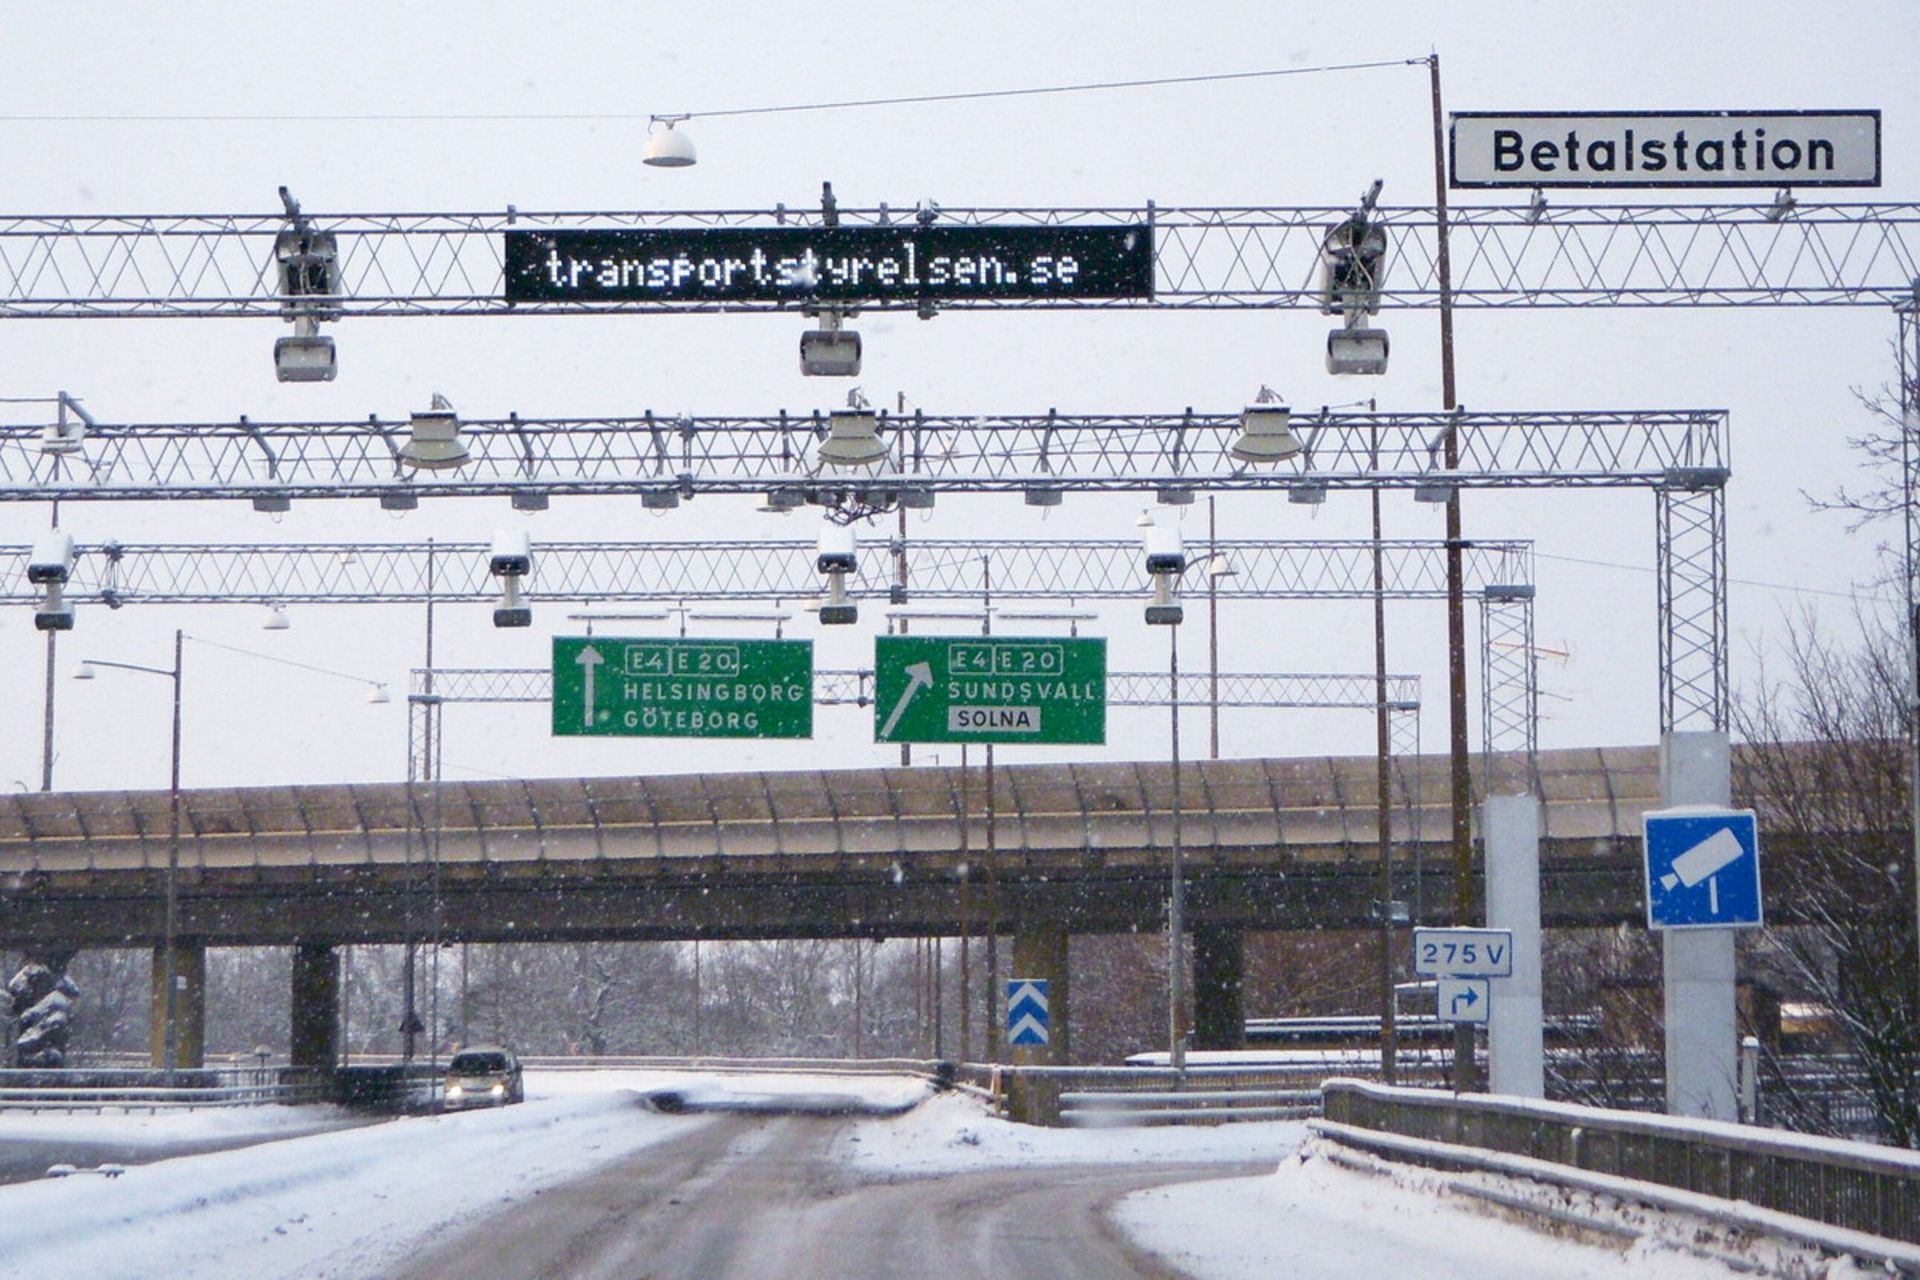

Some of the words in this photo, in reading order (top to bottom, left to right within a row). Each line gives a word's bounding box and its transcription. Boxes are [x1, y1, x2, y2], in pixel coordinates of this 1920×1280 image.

[1493, 128, 1835, 172] Betalstation
[546, 242, 1079, 287] transportstyrelsen.se
[633, 652, 664, 669] E4
[698, 653, 731, 669] 20
[957, 651, 986, 667] E4
[1022, 652, 1054, 669] 20
[623, 683, 804, 702] HELSINGBORG
[949, 682, 1095, 700] SUNDSVALL
[623, 706, 759, 729] GÖTEBORG
[957, 710, 1031, 727] SOLNA
[1423, 943, 1476, 964] 275
[1486, 944, 1504, 965] V
